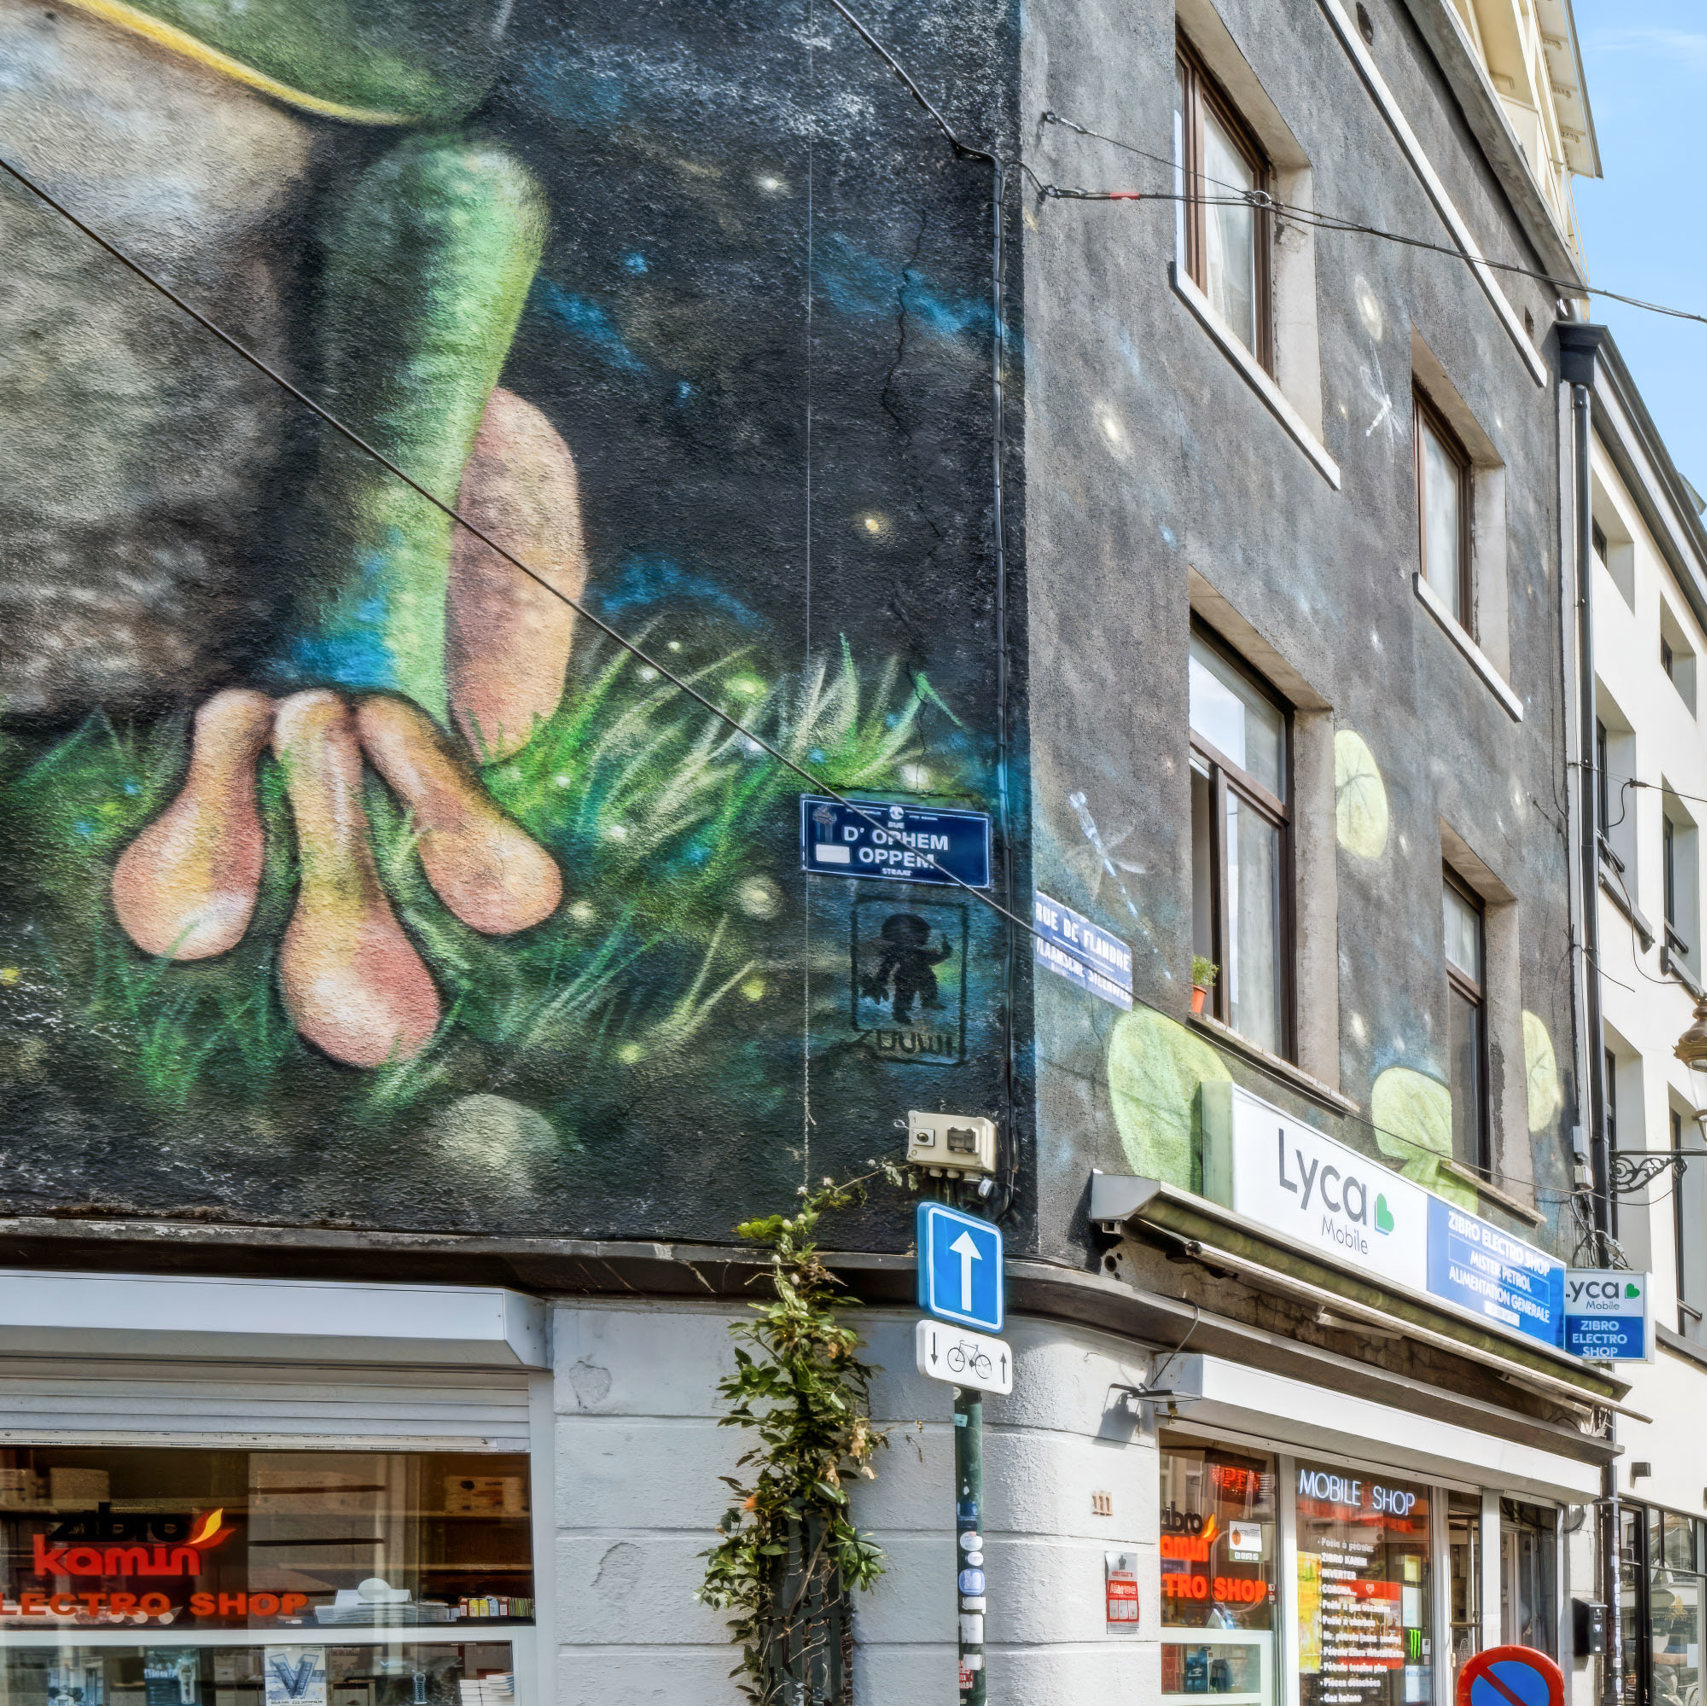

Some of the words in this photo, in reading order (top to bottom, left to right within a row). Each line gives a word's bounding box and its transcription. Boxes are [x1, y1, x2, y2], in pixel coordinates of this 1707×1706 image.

[843, 826, 865, 842] D'
[871, 828, 949, 851] OPHEM
[858, 847, 935, 870] OPPEM
[1035, 902, 1058, 932] RUE
[1083, 929, 1131, 973] FLANDRE
[1278, 1127, 1367, 1227] Lyca
[1321, 1213, 1369, 1255] Mobile
[1448, 1211, 1480, 1242] ZIBRO
[1482, 1228, 1524, 1269] ELECTRO
[1524, 1250, 1550, 1279] SHOP
[1470, 1250, 1502, 1280] MISTER
[1501, 1264, 1532, 1294] PETROL
[1448, 1266, 1511, 1308] ALIMENTATION
[1511, 1294, 1550, 1325] GENERALE
[1566, 1278, 1620, 1304] yca
[1585, 1300, 1621, 1312] Mobile
[1572, 1333, 1628, 1345] ELECTRO
[1580, 1320, 1620, 1332] ZIBRO
[1582, 1346, 1619, 1358] SHOP
[1299, 1468, 1362, 1506] MOBILE
[1371, 1485, 1416, 1517] SHOP
[32, 1533, 201, 1576] kamin
[1160, 1534, 1210, 1563] amin
[1160, 1572, 1208, 1599] TRO
[1213, 1576, 1268, 1604] SHOP
[189, 1591, 310, 1617] SHOP
